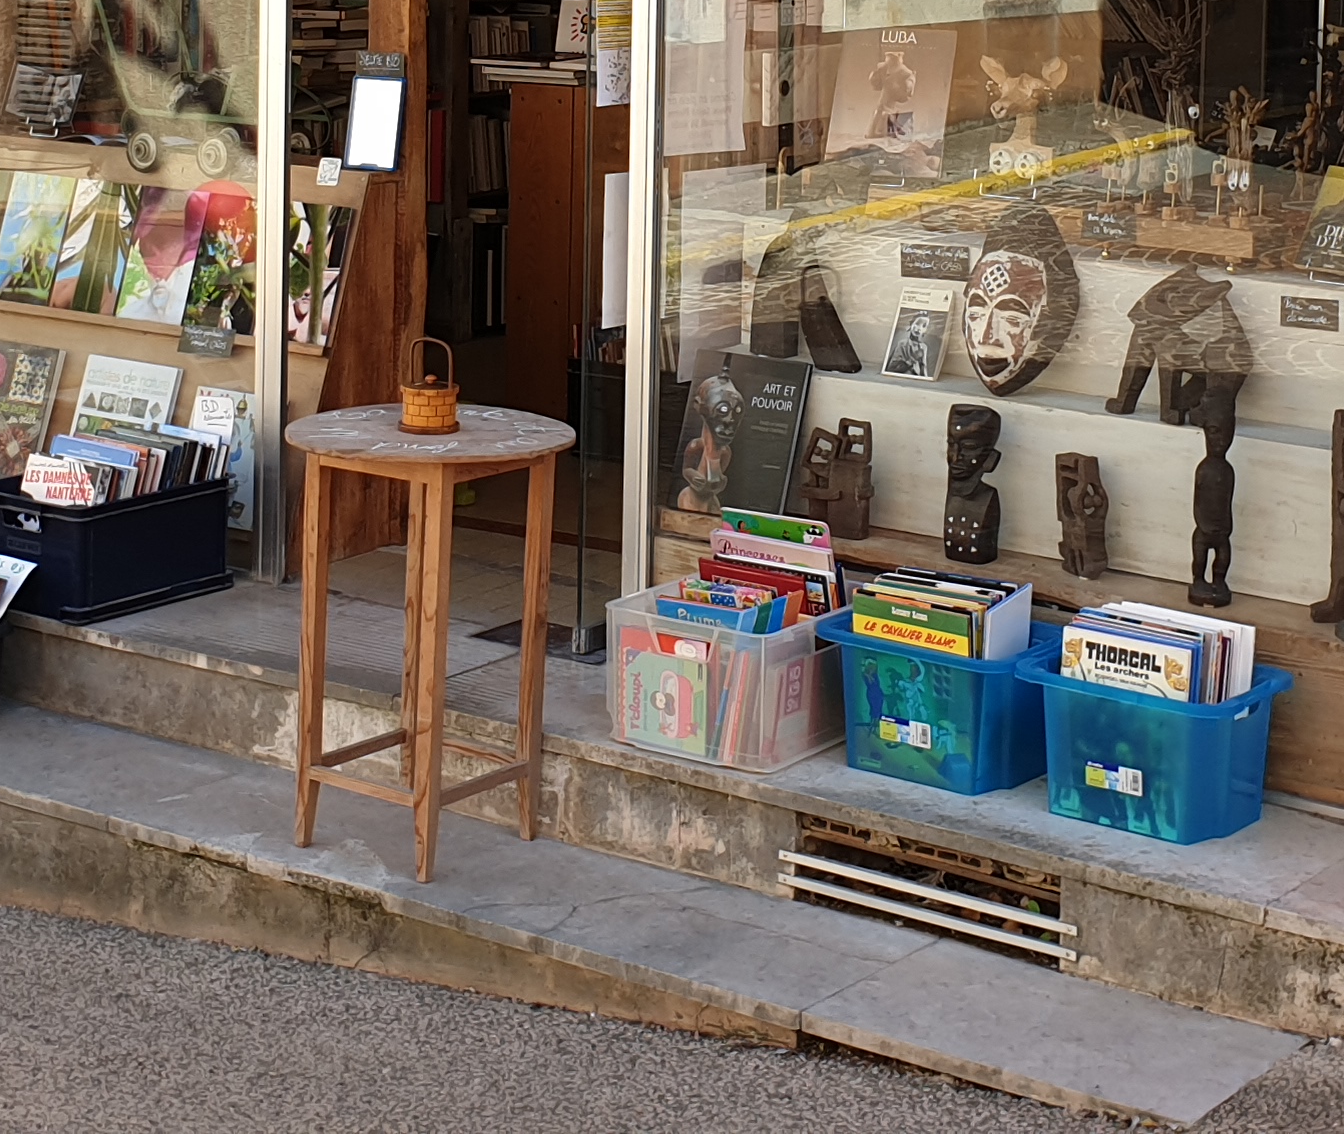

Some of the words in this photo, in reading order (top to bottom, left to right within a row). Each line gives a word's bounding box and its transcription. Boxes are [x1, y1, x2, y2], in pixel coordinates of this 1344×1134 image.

[881, 30, 917, 44] LUBA
[123, 368, 137, 385] de
[762, 383, 782, 396] ART
[783, 385, 797, 398] ET
[201, 399, 220, 413] BD
[751, 396, 793, 412] POUVOIR
[24, 469, 41, 483] LES
[45, 485, 93, 502] NANTERRE
[717, 538, 786, 563] Princesses
[864, 620, 877, 632] LE
[881, 623, 923, 642] CAVALIER
[924, 634, 957, 649] BLANC
[1086, 640, 1162, 674] THORGAL
[1095, 661, 1111, 672] Les
[1113, 667, 1150, 680] archers
